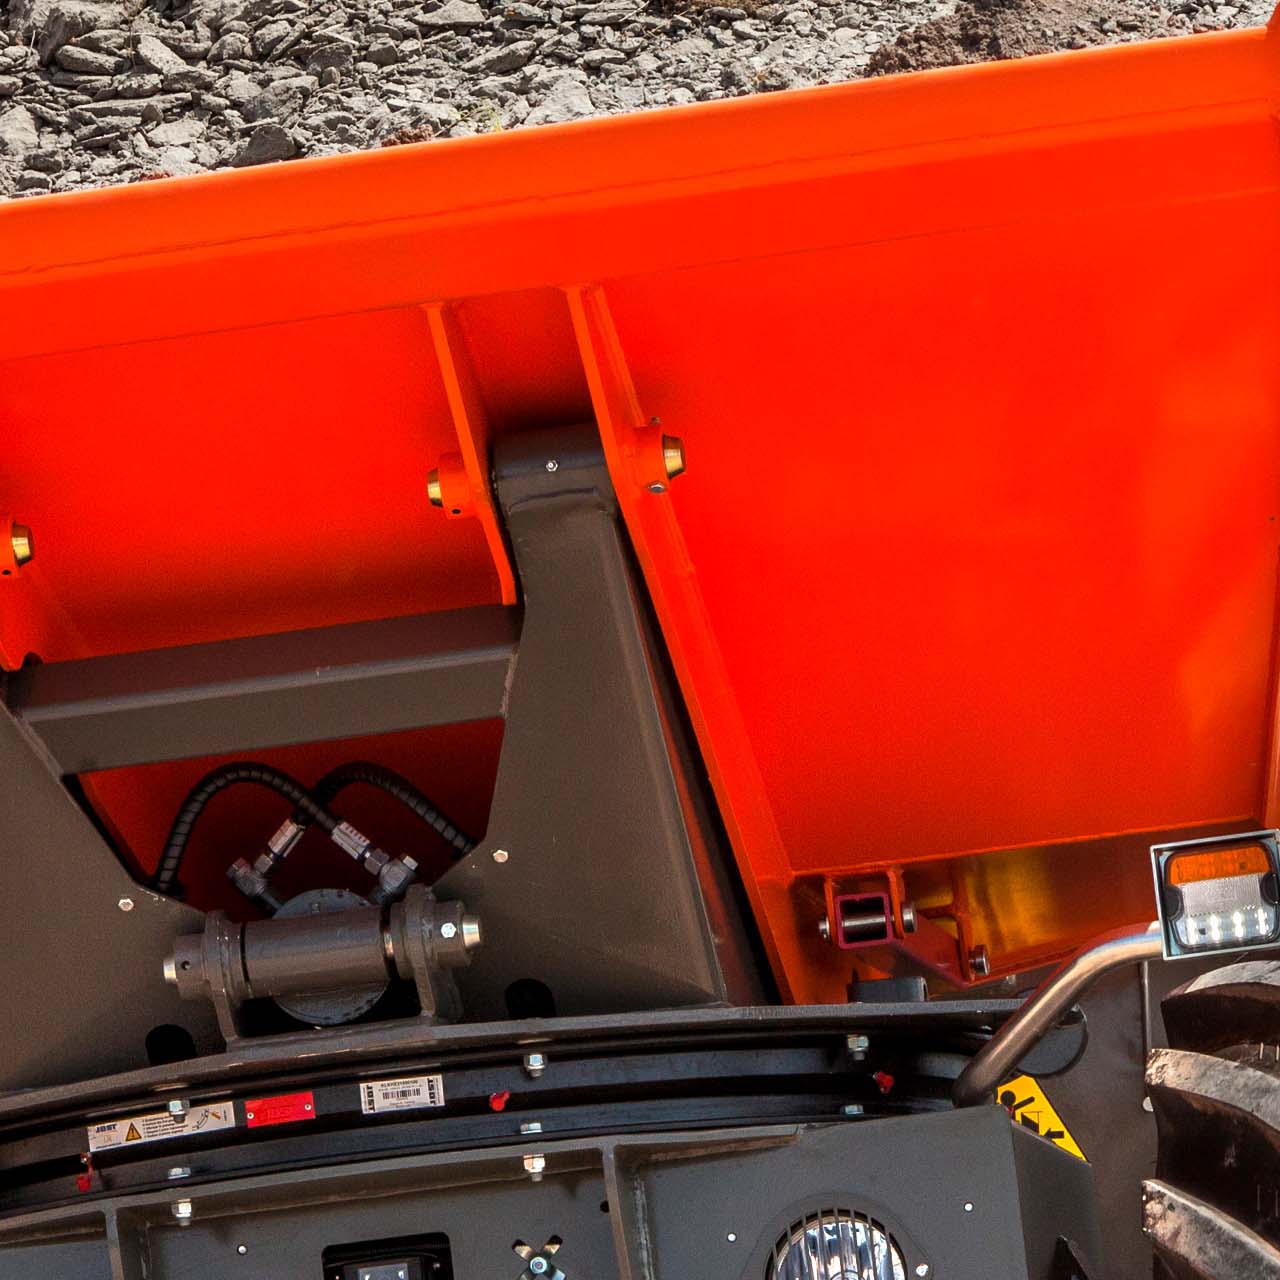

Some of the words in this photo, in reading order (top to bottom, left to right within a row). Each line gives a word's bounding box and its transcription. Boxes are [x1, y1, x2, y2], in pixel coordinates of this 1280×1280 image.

[366, 1084, 376, 1112] JOST
[427, 1078, 437, 1105] JOST
[96, 1123, 117, 1133] JOST
